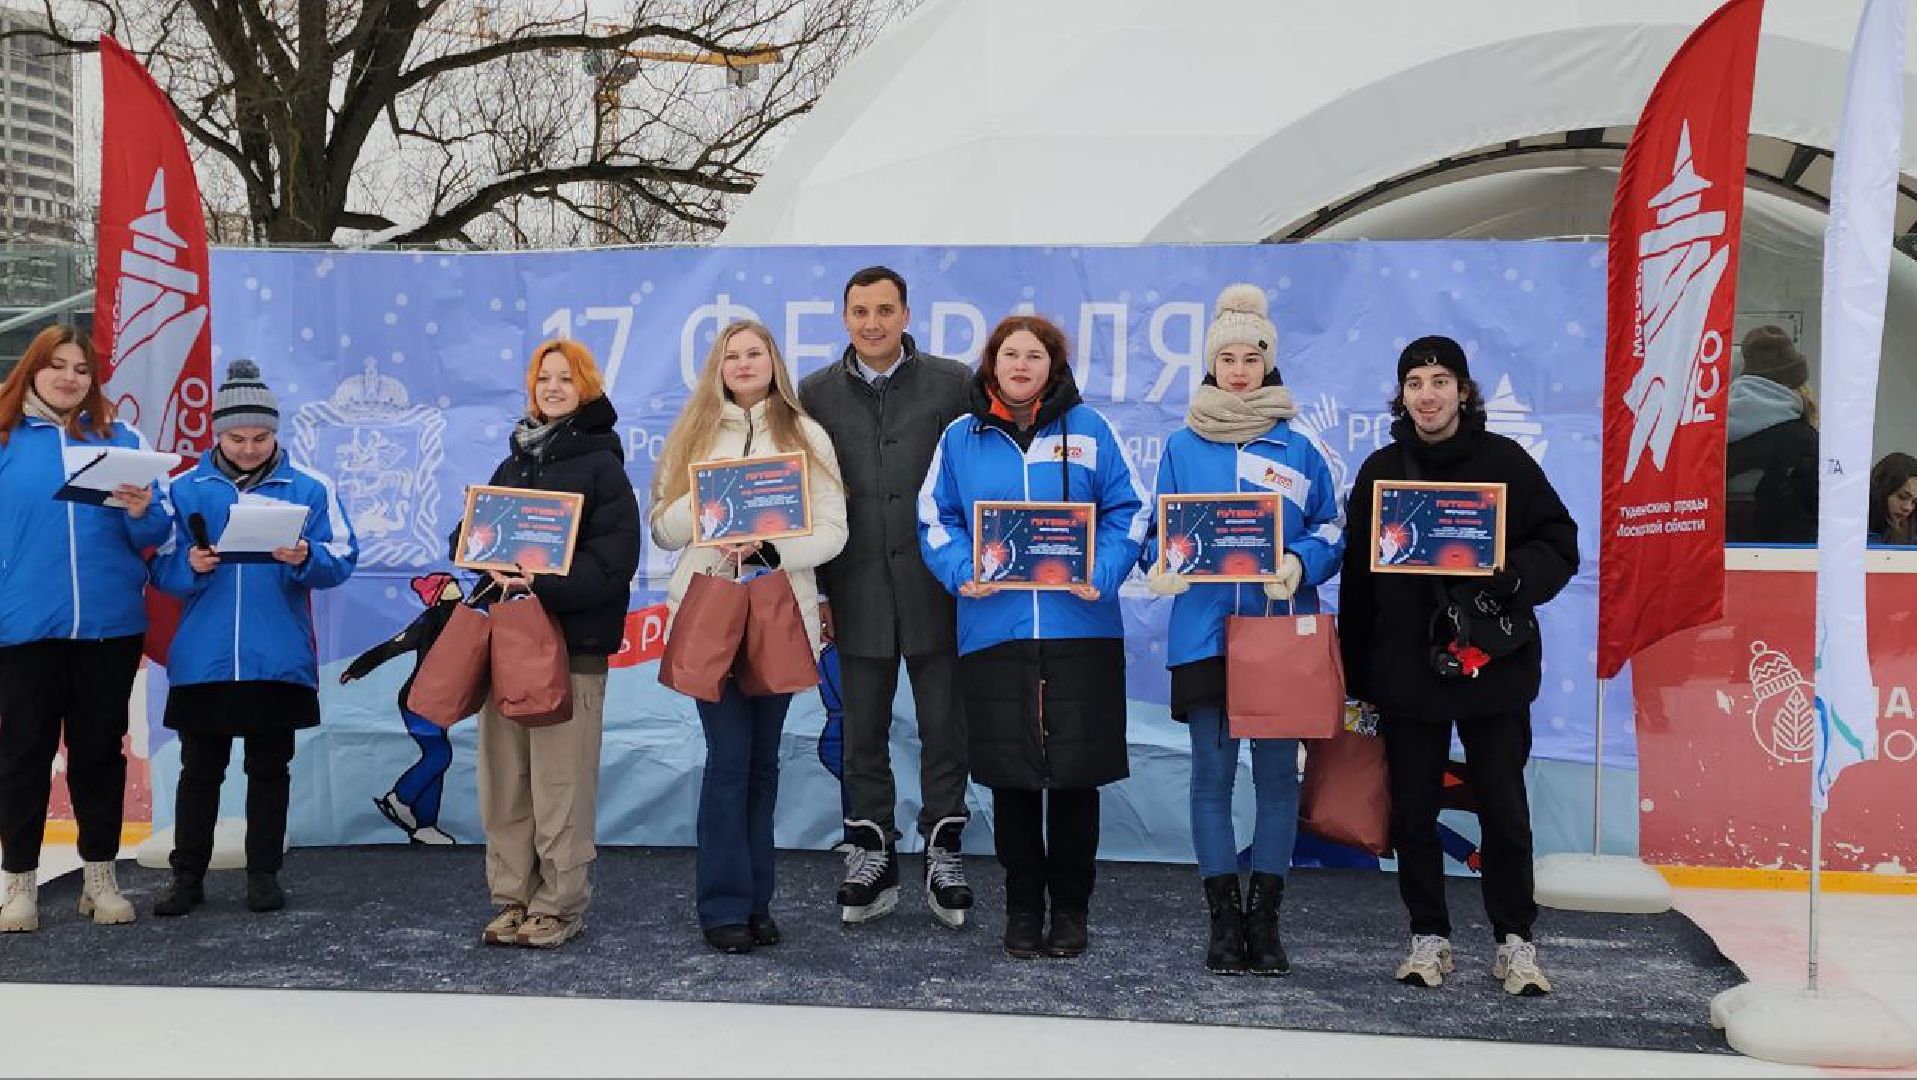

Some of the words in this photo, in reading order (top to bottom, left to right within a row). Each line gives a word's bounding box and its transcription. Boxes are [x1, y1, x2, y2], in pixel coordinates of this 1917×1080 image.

[680, 294, 1205, 403] ФЕРЛЯ
[1693, 329, 1724, 423] РСО
[1349, 413, 1393, 453] РС
